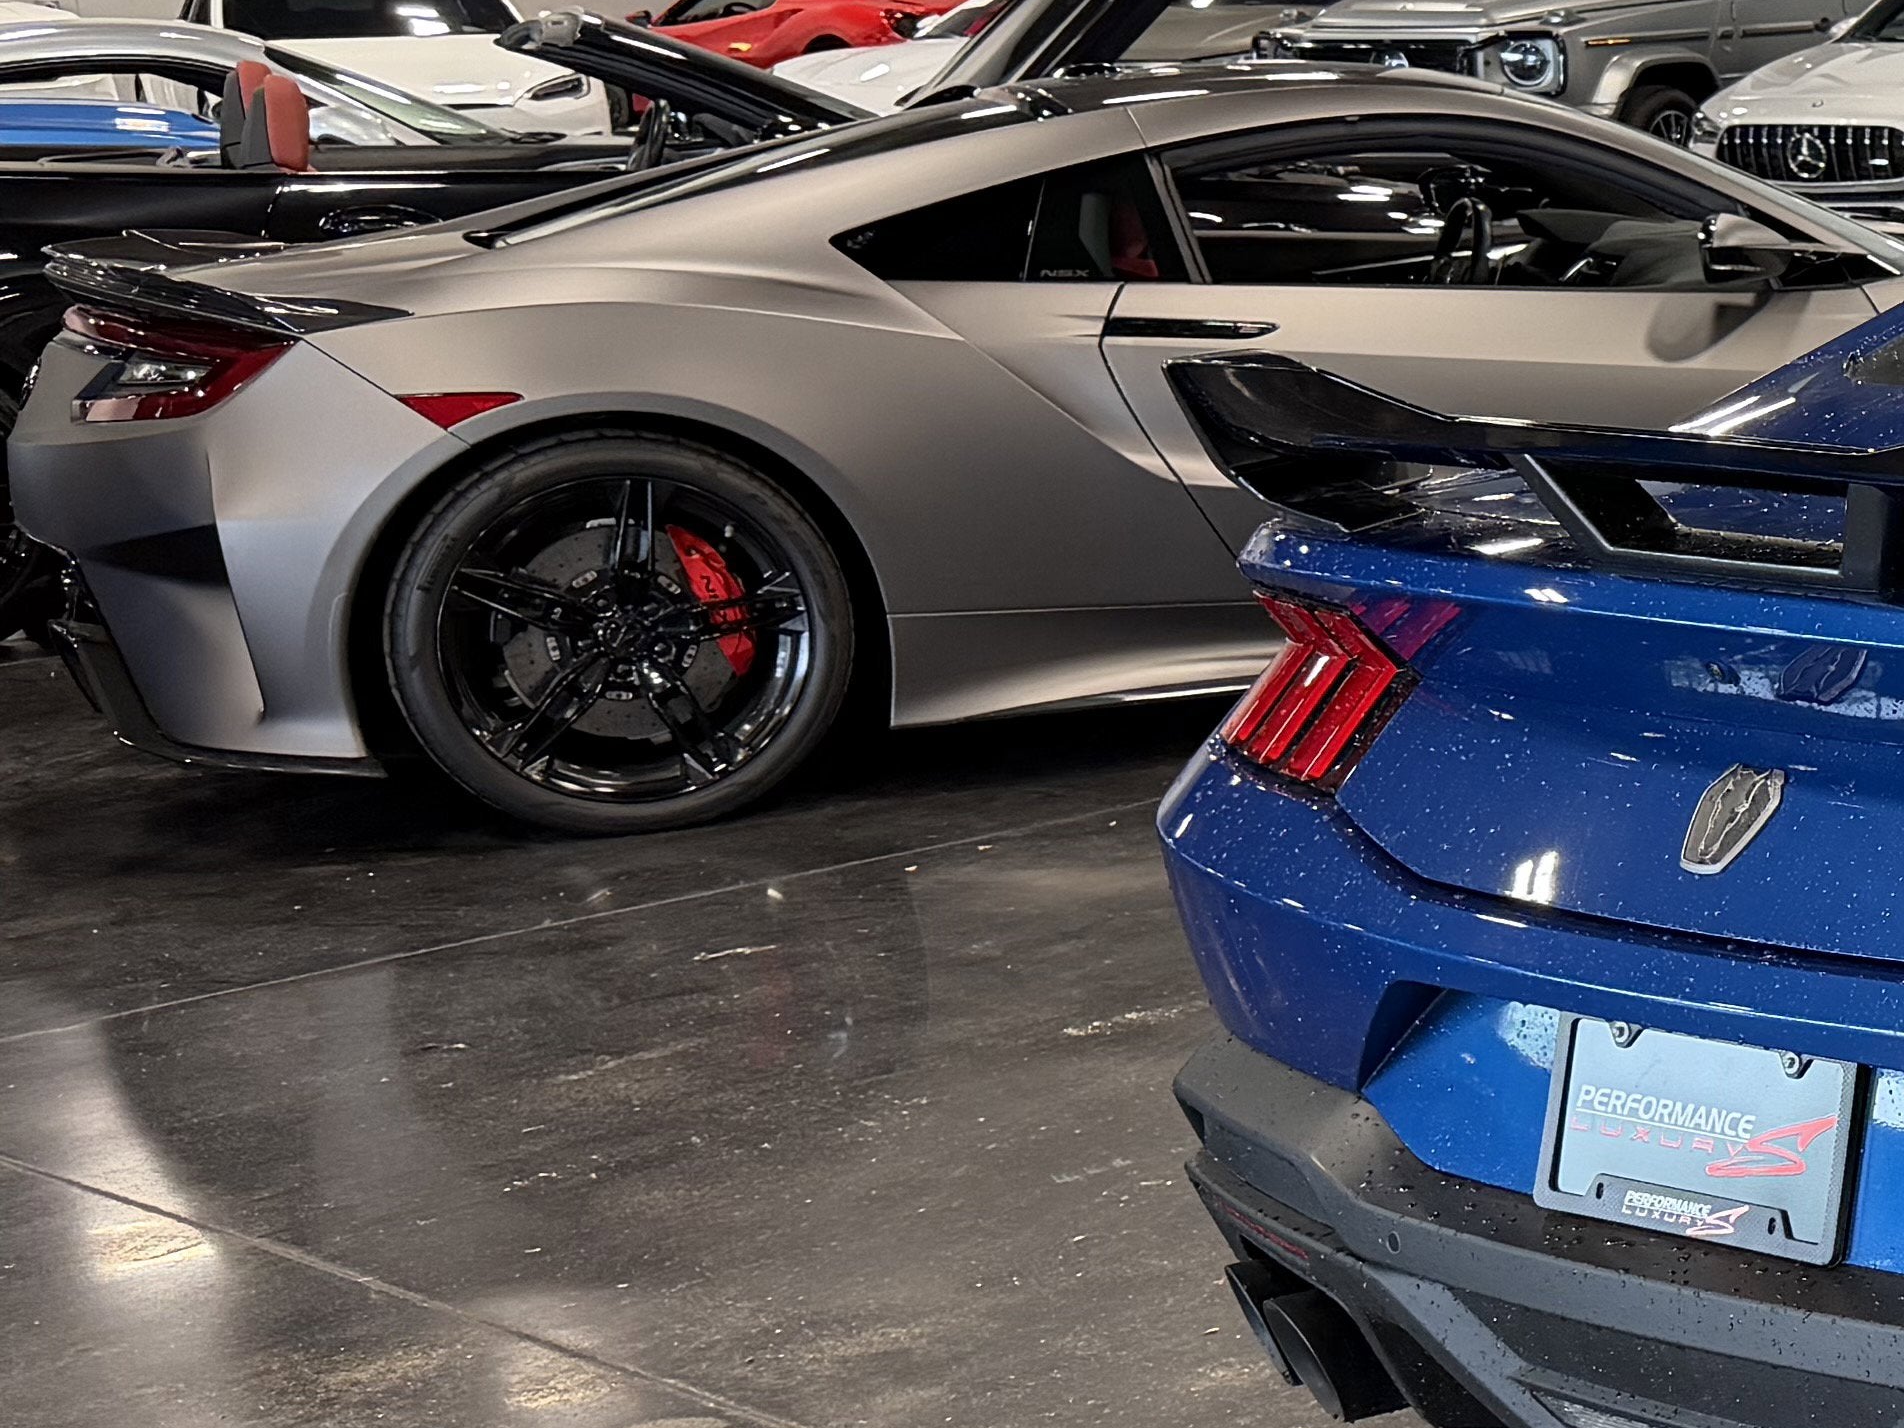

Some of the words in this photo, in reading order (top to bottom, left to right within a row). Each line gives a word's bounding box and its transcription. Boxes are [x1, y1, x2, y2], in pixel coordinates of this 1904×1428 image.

[1576, 1084, 1756, 1139] PERFORMANCE
[1571, 1117, 1746, 1157] LUXURY
[1622, 1205, 1705, 1226] LUXURY
[1623, 1190, 1712, 1217] PERFORMANCE
